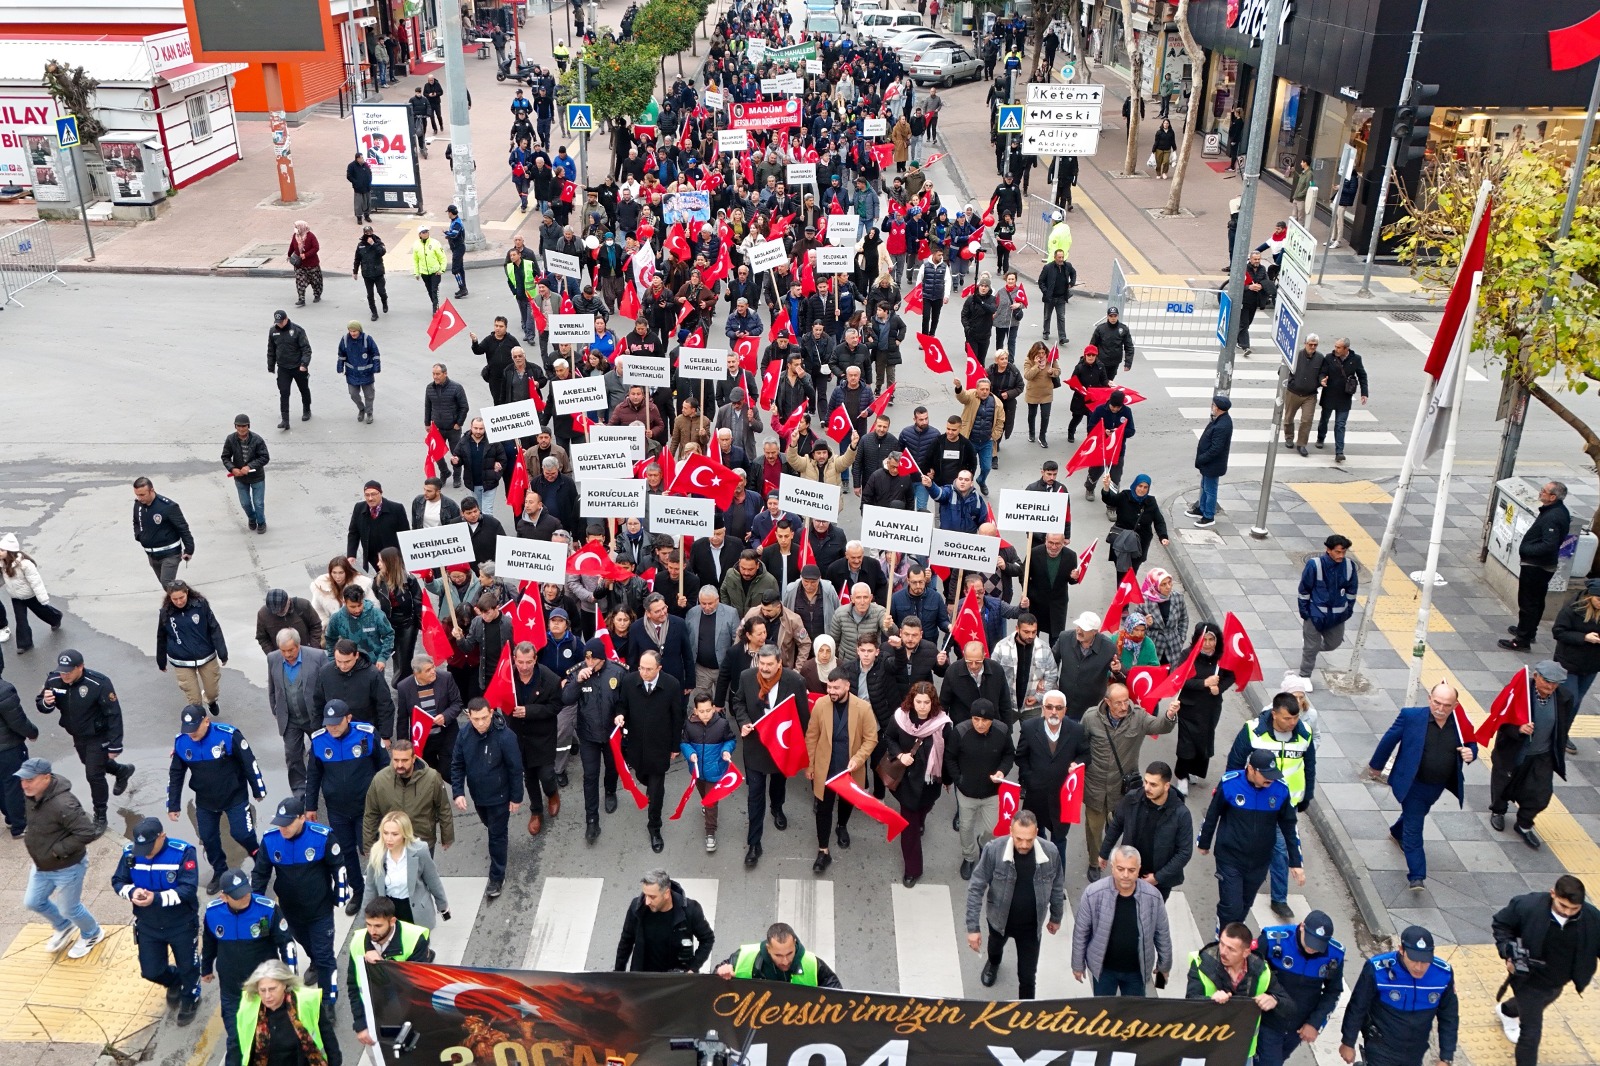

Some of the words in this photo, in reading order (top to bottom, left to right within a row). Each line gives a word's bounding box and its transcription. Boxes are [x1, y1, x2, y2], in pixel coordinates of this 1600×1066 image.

[1239, 0, 1291, 48] arçek
[161, 44, 177, 61] KAN
[176, 38, 190, 57] BAĞ
[1040, 89, 1088, 100] Ketem
[0, 106, 49, 124] ILAY
[748, 105, 783, 114] MADÜM
[1040, 110, 1090, 120] Meski
[1038, 129, 1079, 140] Adliye
[362, 134, 407, 154] 104
[1289, 232, 1308, 261] Ketem
[755, 253, 784, 266] MUHTARLIĞI
[1284, 267, 1304, 299] Toroslar
[1167, 302, 1194, 314] POLİS
[1280, 307, 1296, 340] Tarsus
[1277, 327, 1293, 360] Silifke
[689, 356, 718, 364] ÇELEBİLİ
[627, 363, 665, 372] YÜKSEKOLUK
[684, 364, 723, 372] MUHTARLIĞI
[629, 371, 664, 379] MUHTARLIĞI
[562, 386, 597, 396] AKBELEN
[558, 394, 604, 405] MUHTARLIĞI
[490, 410, 531, 424] ÇAMLIDERE
[490, 419, 534, 433] MUHTARLIĞI
[577, 452, 627, 462] GÜZELYAYLA
[579, 462, 627, 471] MUHTARLIĞI
[587, 490, 639, 498] KORUCULAR
[794, 488, 824, 500] ÇANDIR
[587, 500, 639, 508] MUHTARLIĞI
[784, 495, 833, 512] MUHTARLIĞI
[1016, 502, 1050, 512] KEPİRLİ
[664, 507, 700, 517] DEĞNEK
[1005, 512, 1059, 523] MUHTARLIĞI
[656, 517, 708, 527] MUHTARLIĞI
[875, 519, 919, 532] ALANYALI
[412, 535, 460, 550] KERİMLER
[868, 530, 924, 544] MUHTARLIĞI
[943, 540, 986, 553] SOĞUCAK
[410, 545, 466, 561] MUHTARLIĞI
[511, 549, 552, 561] PORTAKAL
[937, 549, 991, 563] MUHTARLIĞI
[507, 559, 555, 572] MUHTARLIĞI
[969, 1000, 1235, 1042] Kurtuluşunun
